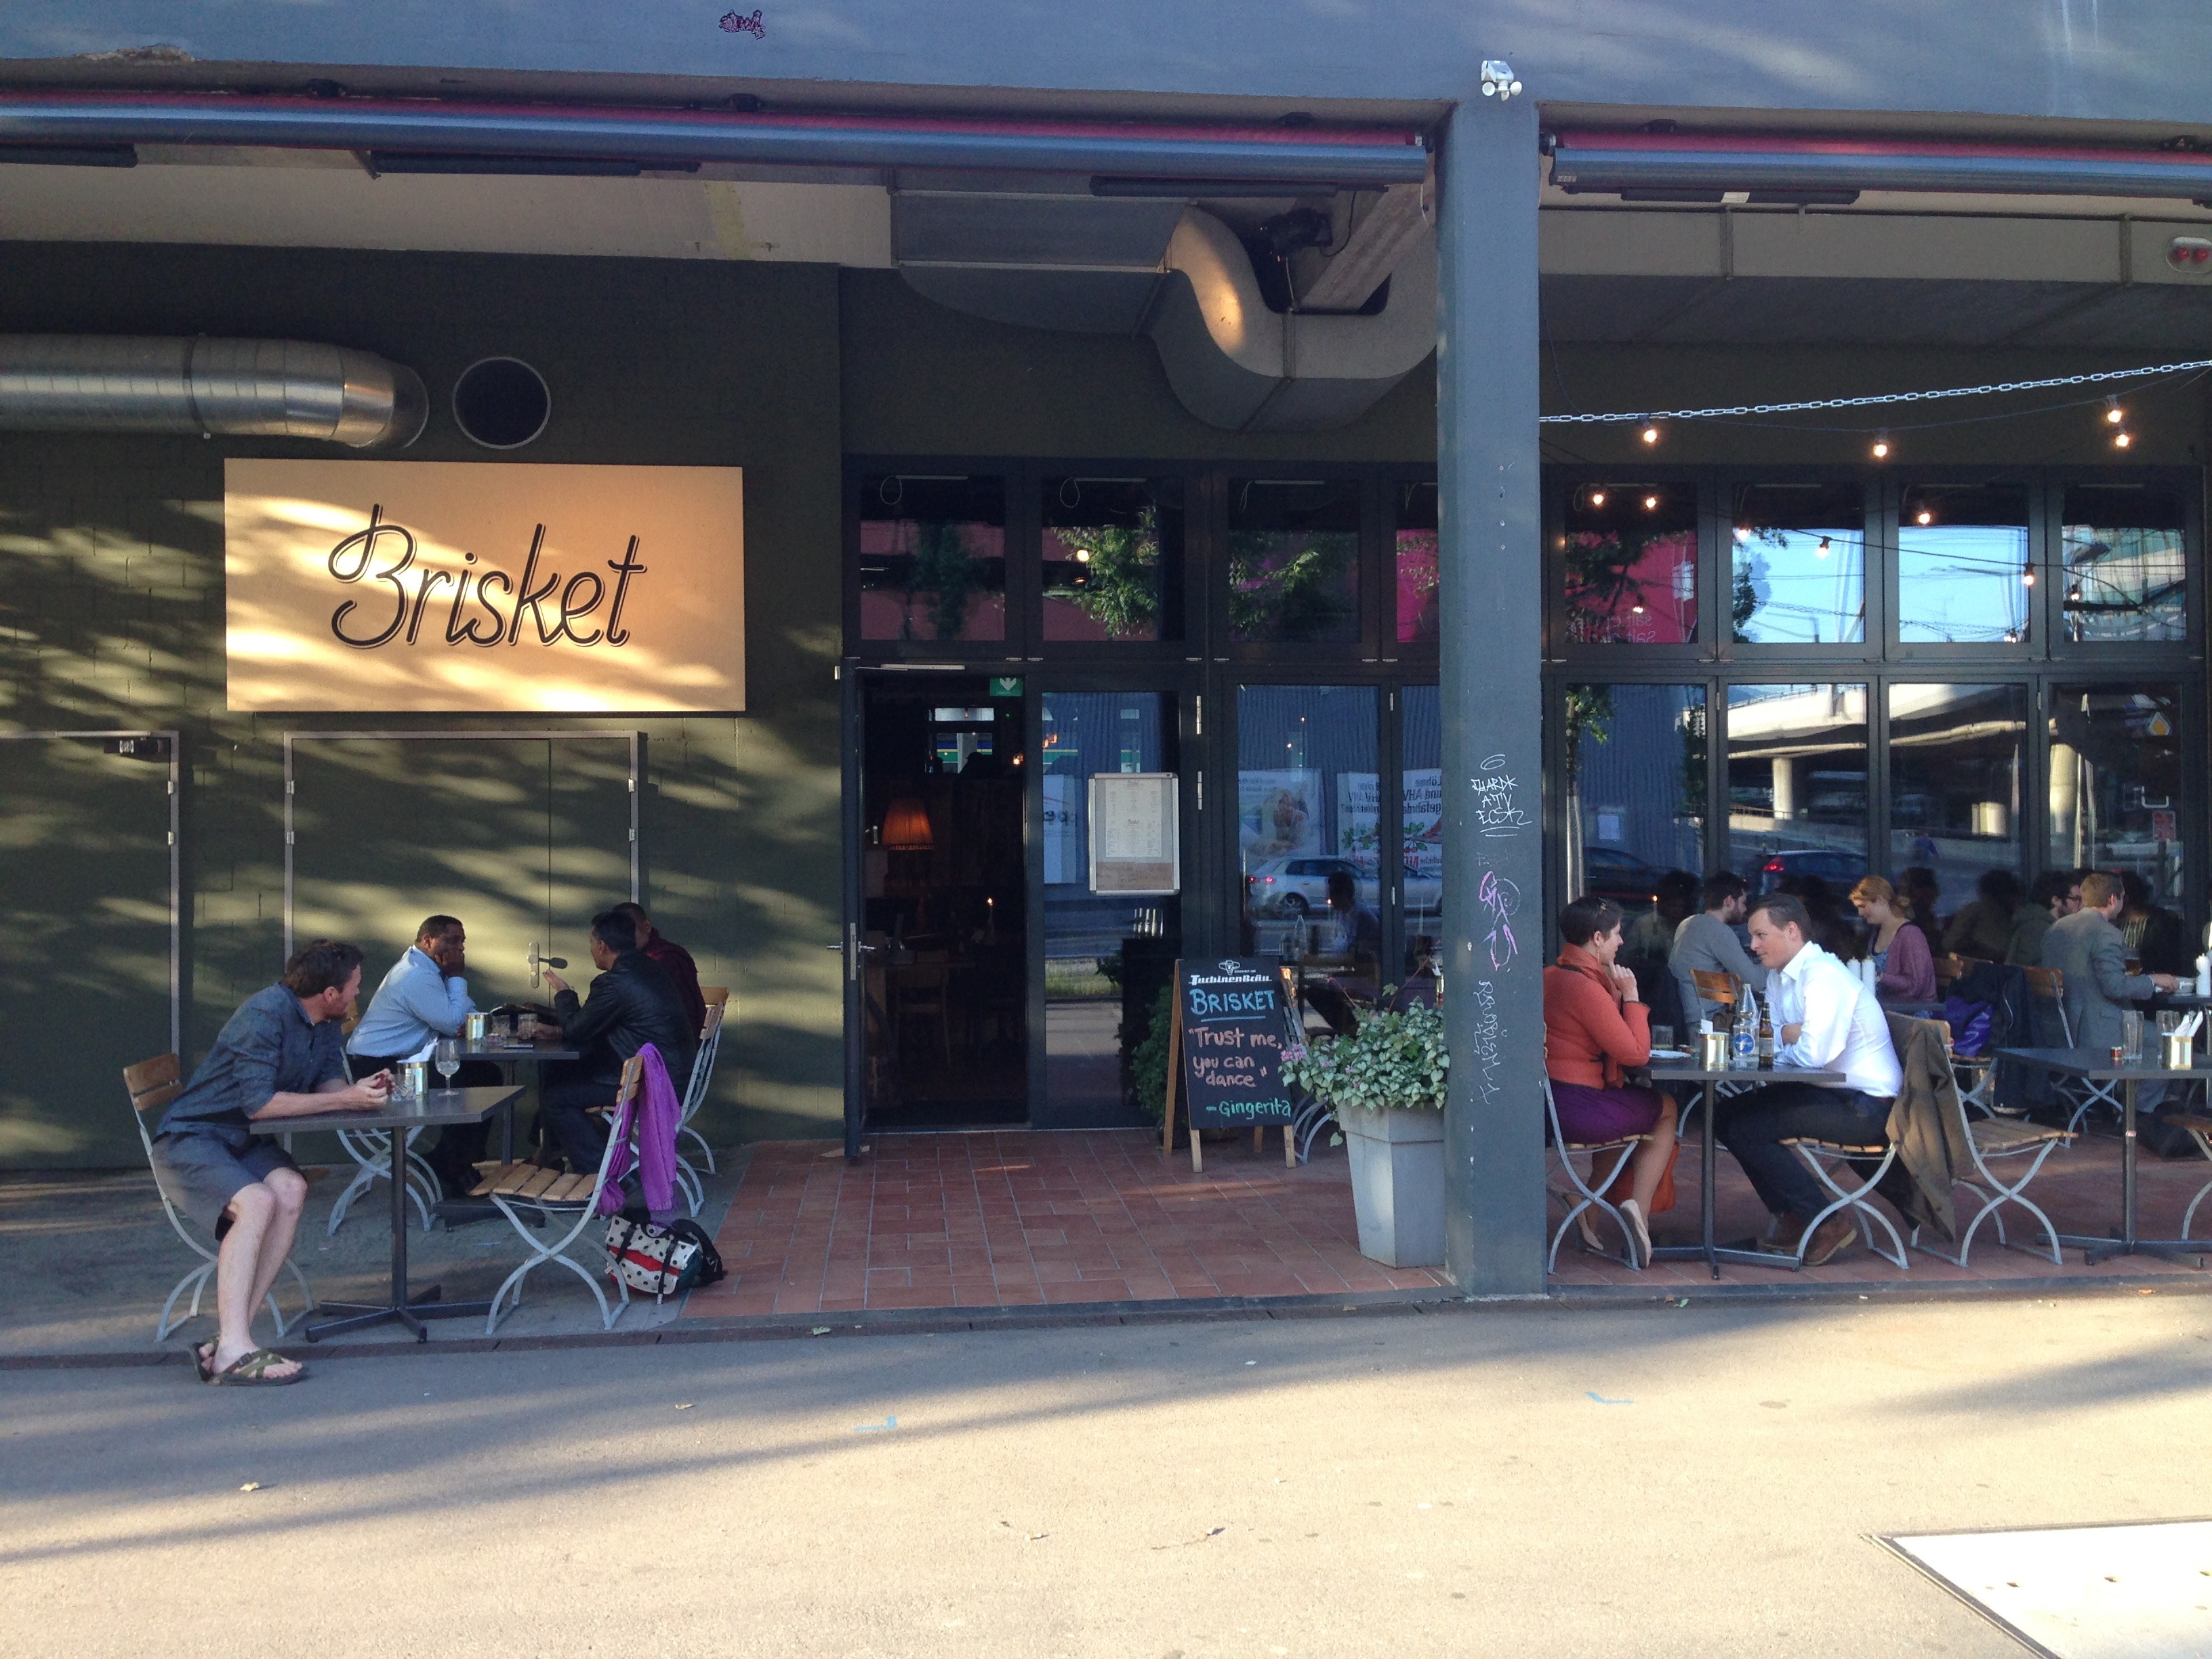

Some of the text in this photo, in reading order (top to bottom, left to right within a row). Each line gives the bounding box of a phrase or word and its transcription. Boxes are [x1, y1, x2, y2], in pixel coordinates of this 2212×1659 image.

[328, 503, 648, 648] Brisket
[1189, 988, 1275, 1015] BRISKET
[1193, 1056, 1255, 1078] you can
